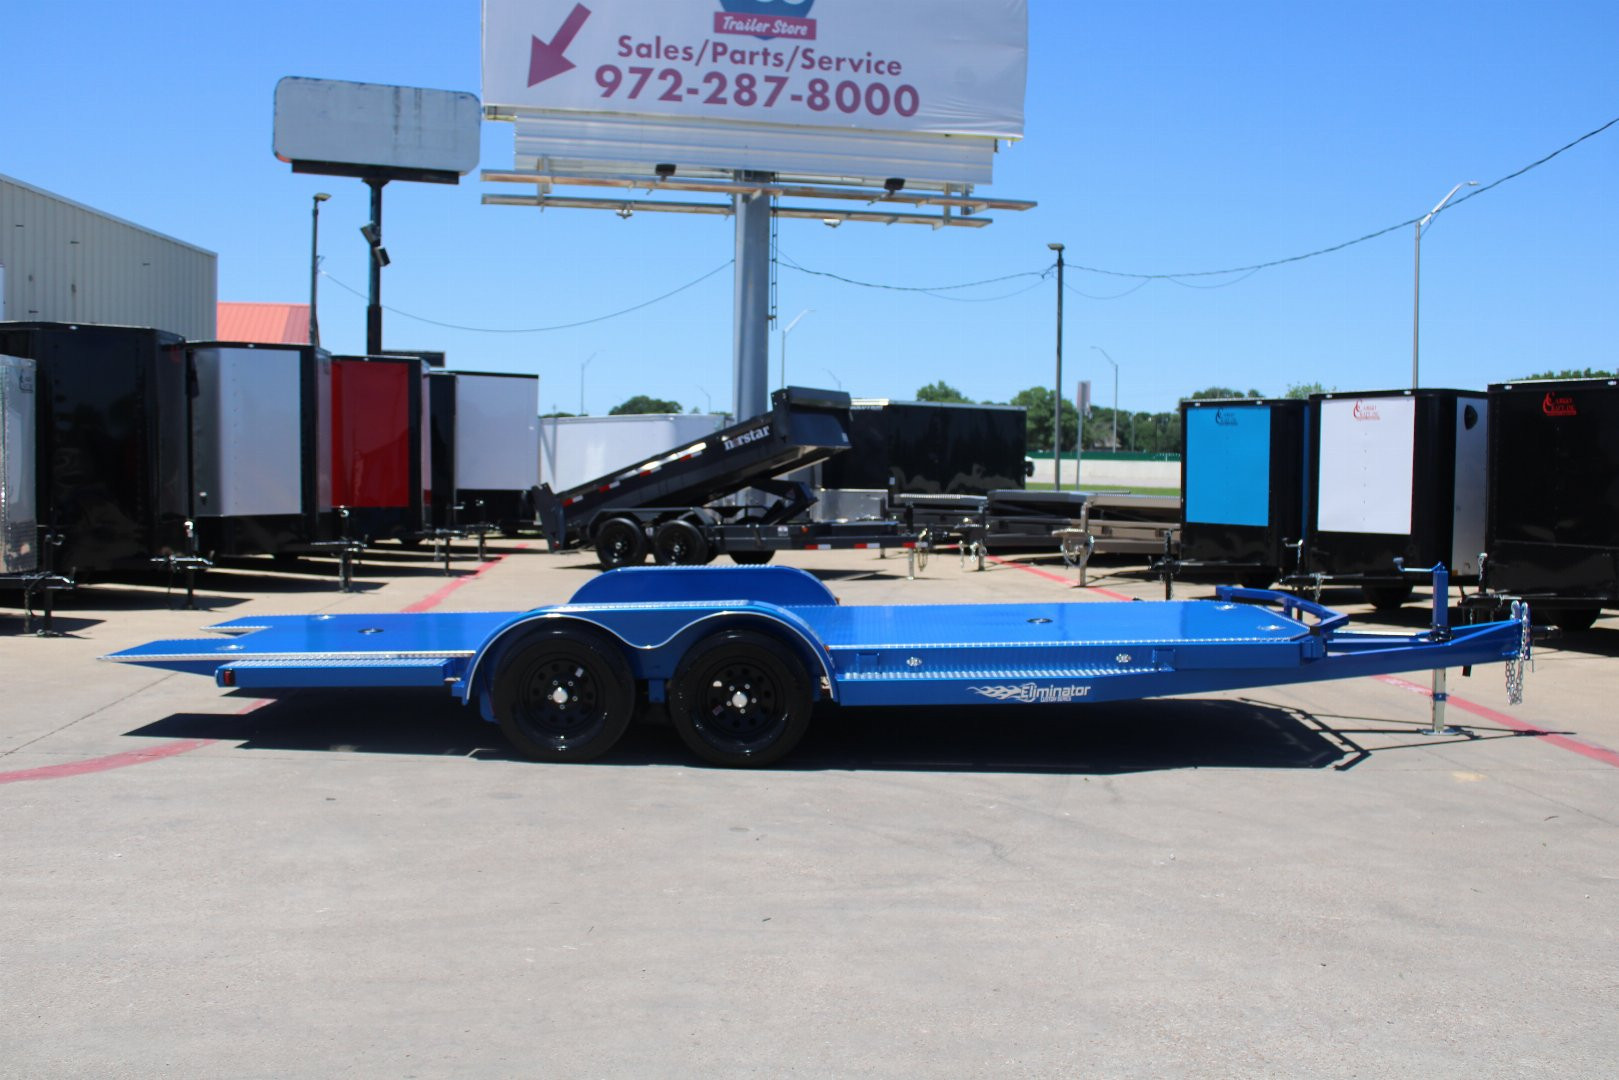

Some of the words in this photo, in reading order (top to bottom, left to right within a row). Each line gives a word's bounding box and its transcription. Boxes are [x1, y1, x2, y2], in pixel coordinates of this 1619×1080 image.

[723, 16, 770, 33] Trailer
[772, 19, 809, 36] Store
[617, 34, 902, 76] Sales/Parts/Service
[595, 64, 920, 117] 972-287-8000
[1020, 683, 1092, 698] Eliminator
